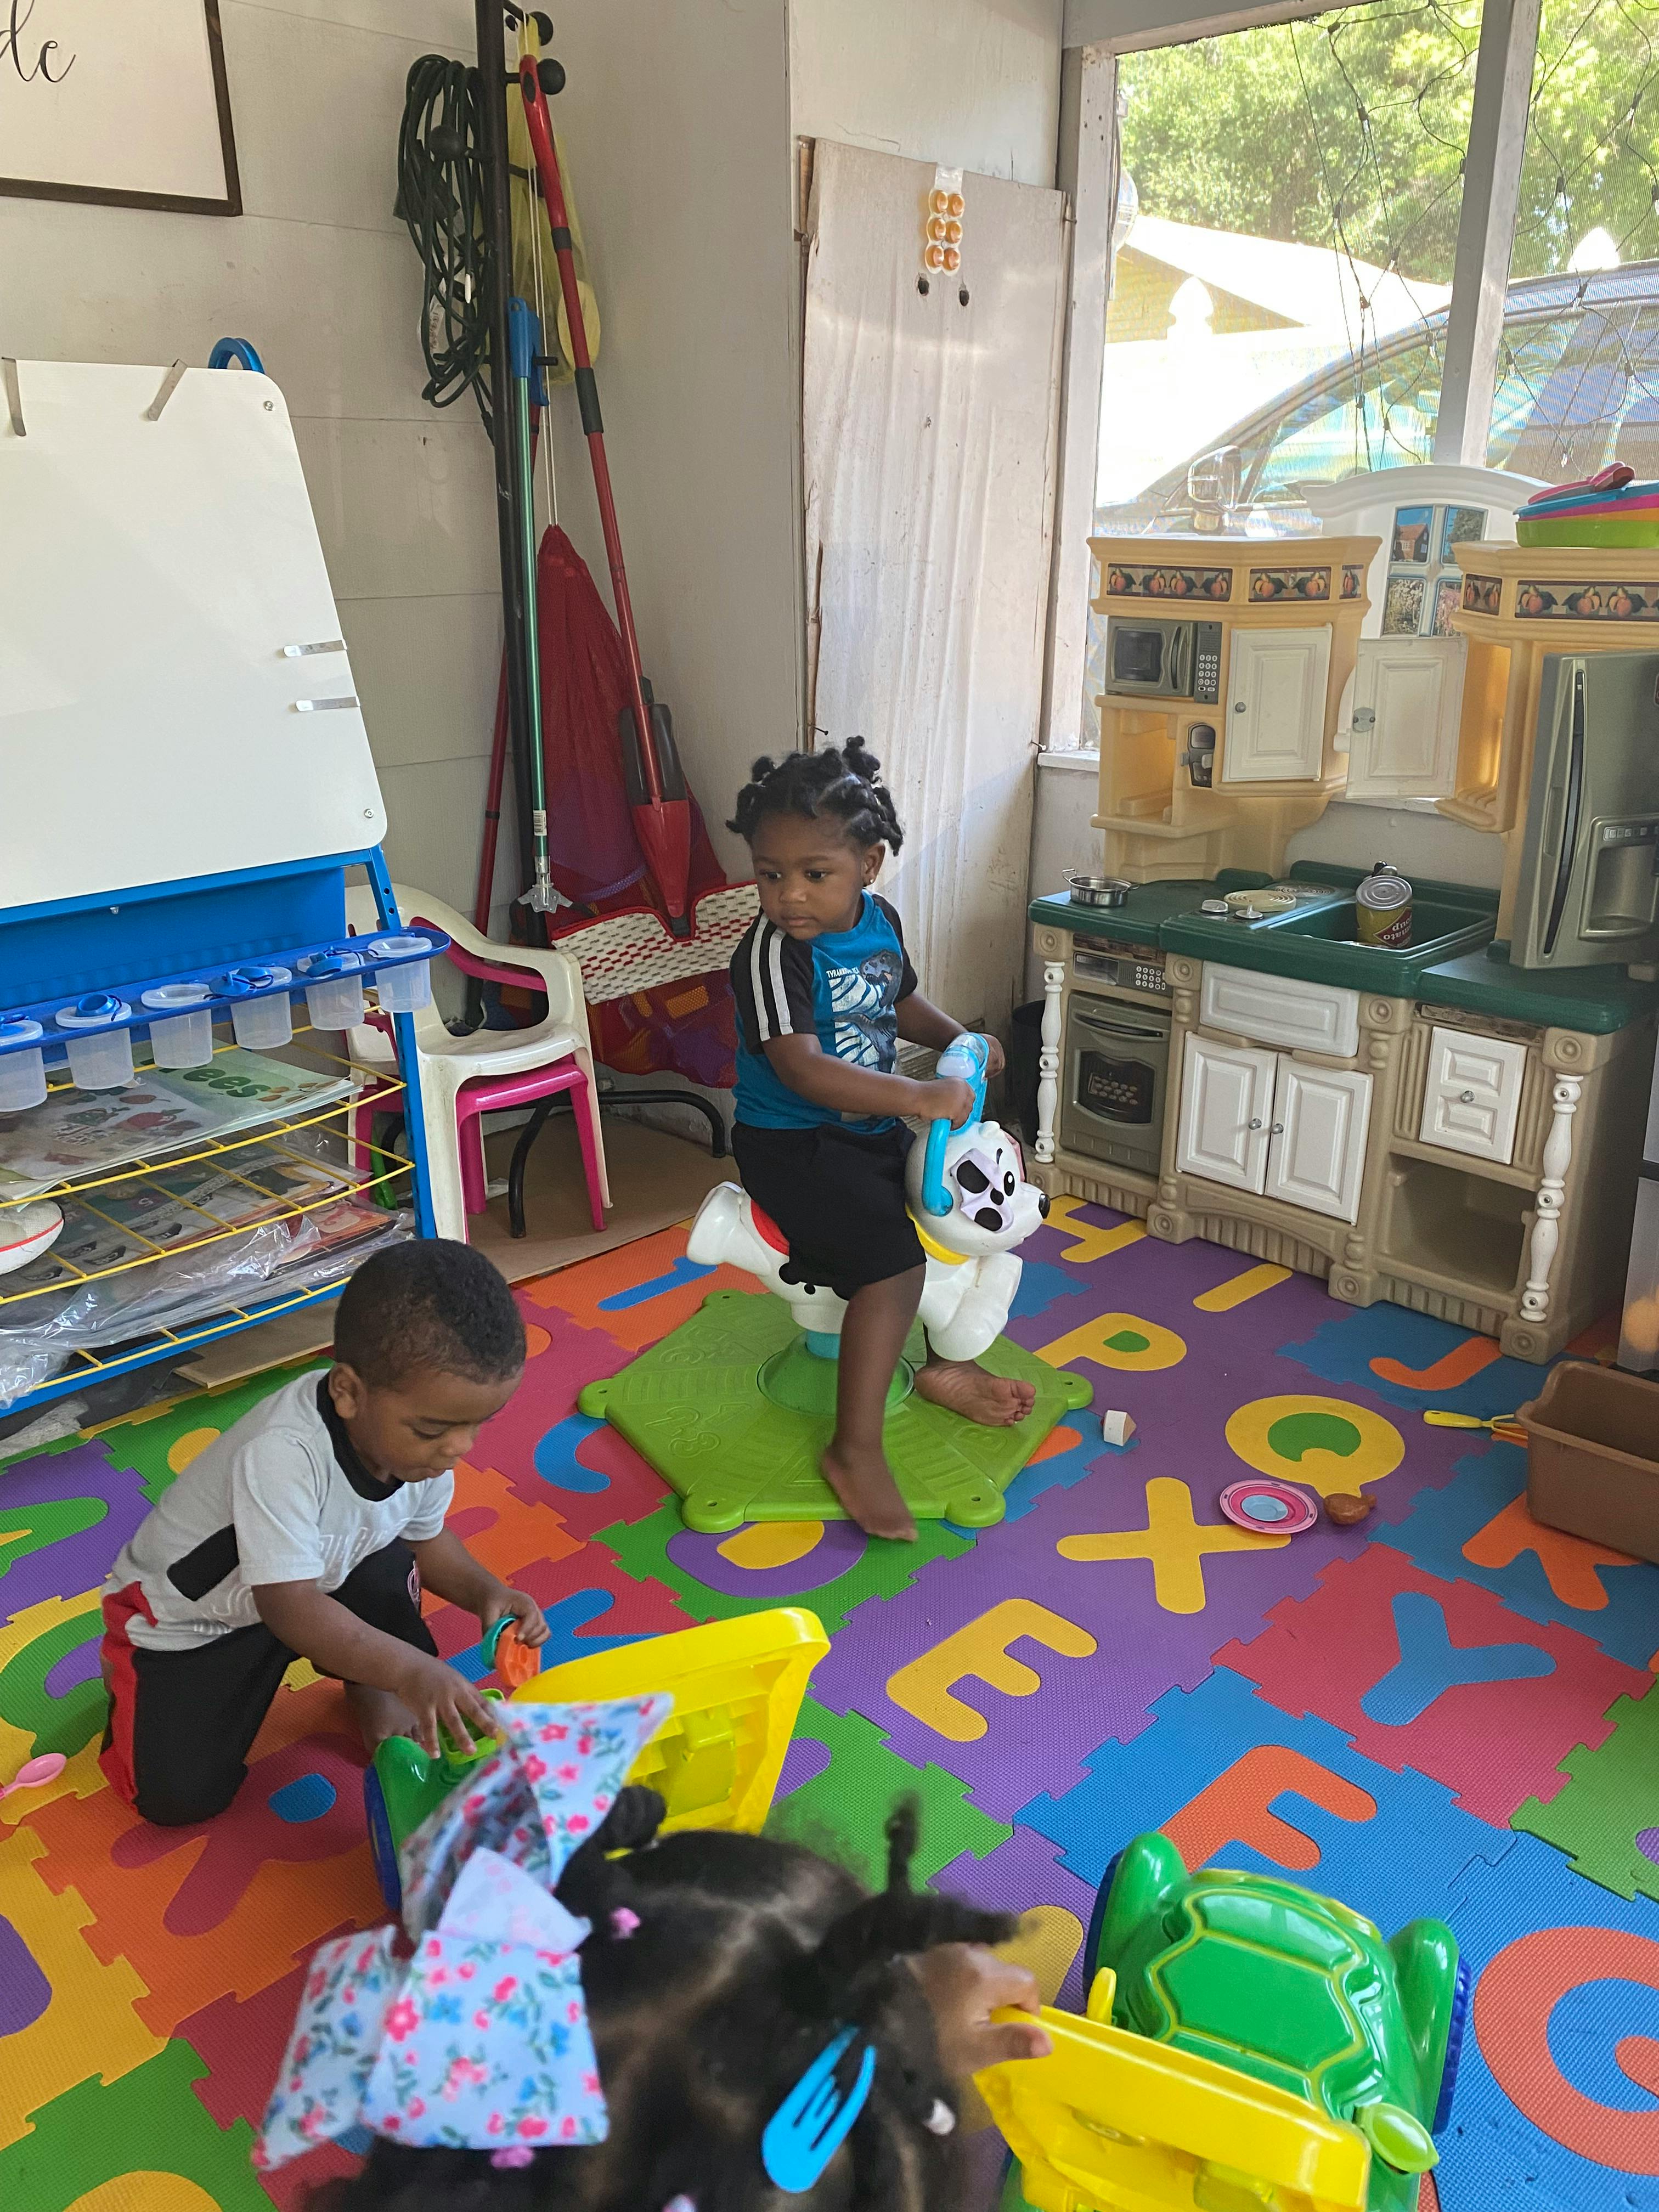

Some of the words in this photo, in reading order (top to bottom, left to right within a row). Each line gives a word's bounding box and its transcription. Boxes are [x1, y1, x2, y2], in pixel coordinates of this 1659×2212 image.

[1032, 1312, 1187, 1371] P
[1369, 1336, 1503, 1390] J
[1224, 1394, 1406, 1498] Q
[1057, 1477, 1292, 1614] X
[886, 1598, 1098, 1742] E
[1361, 1592, 1557, 1726] Y
[1157, 1745, 1378, 1871] F
[1473, 1926, 1659, 2177] G
